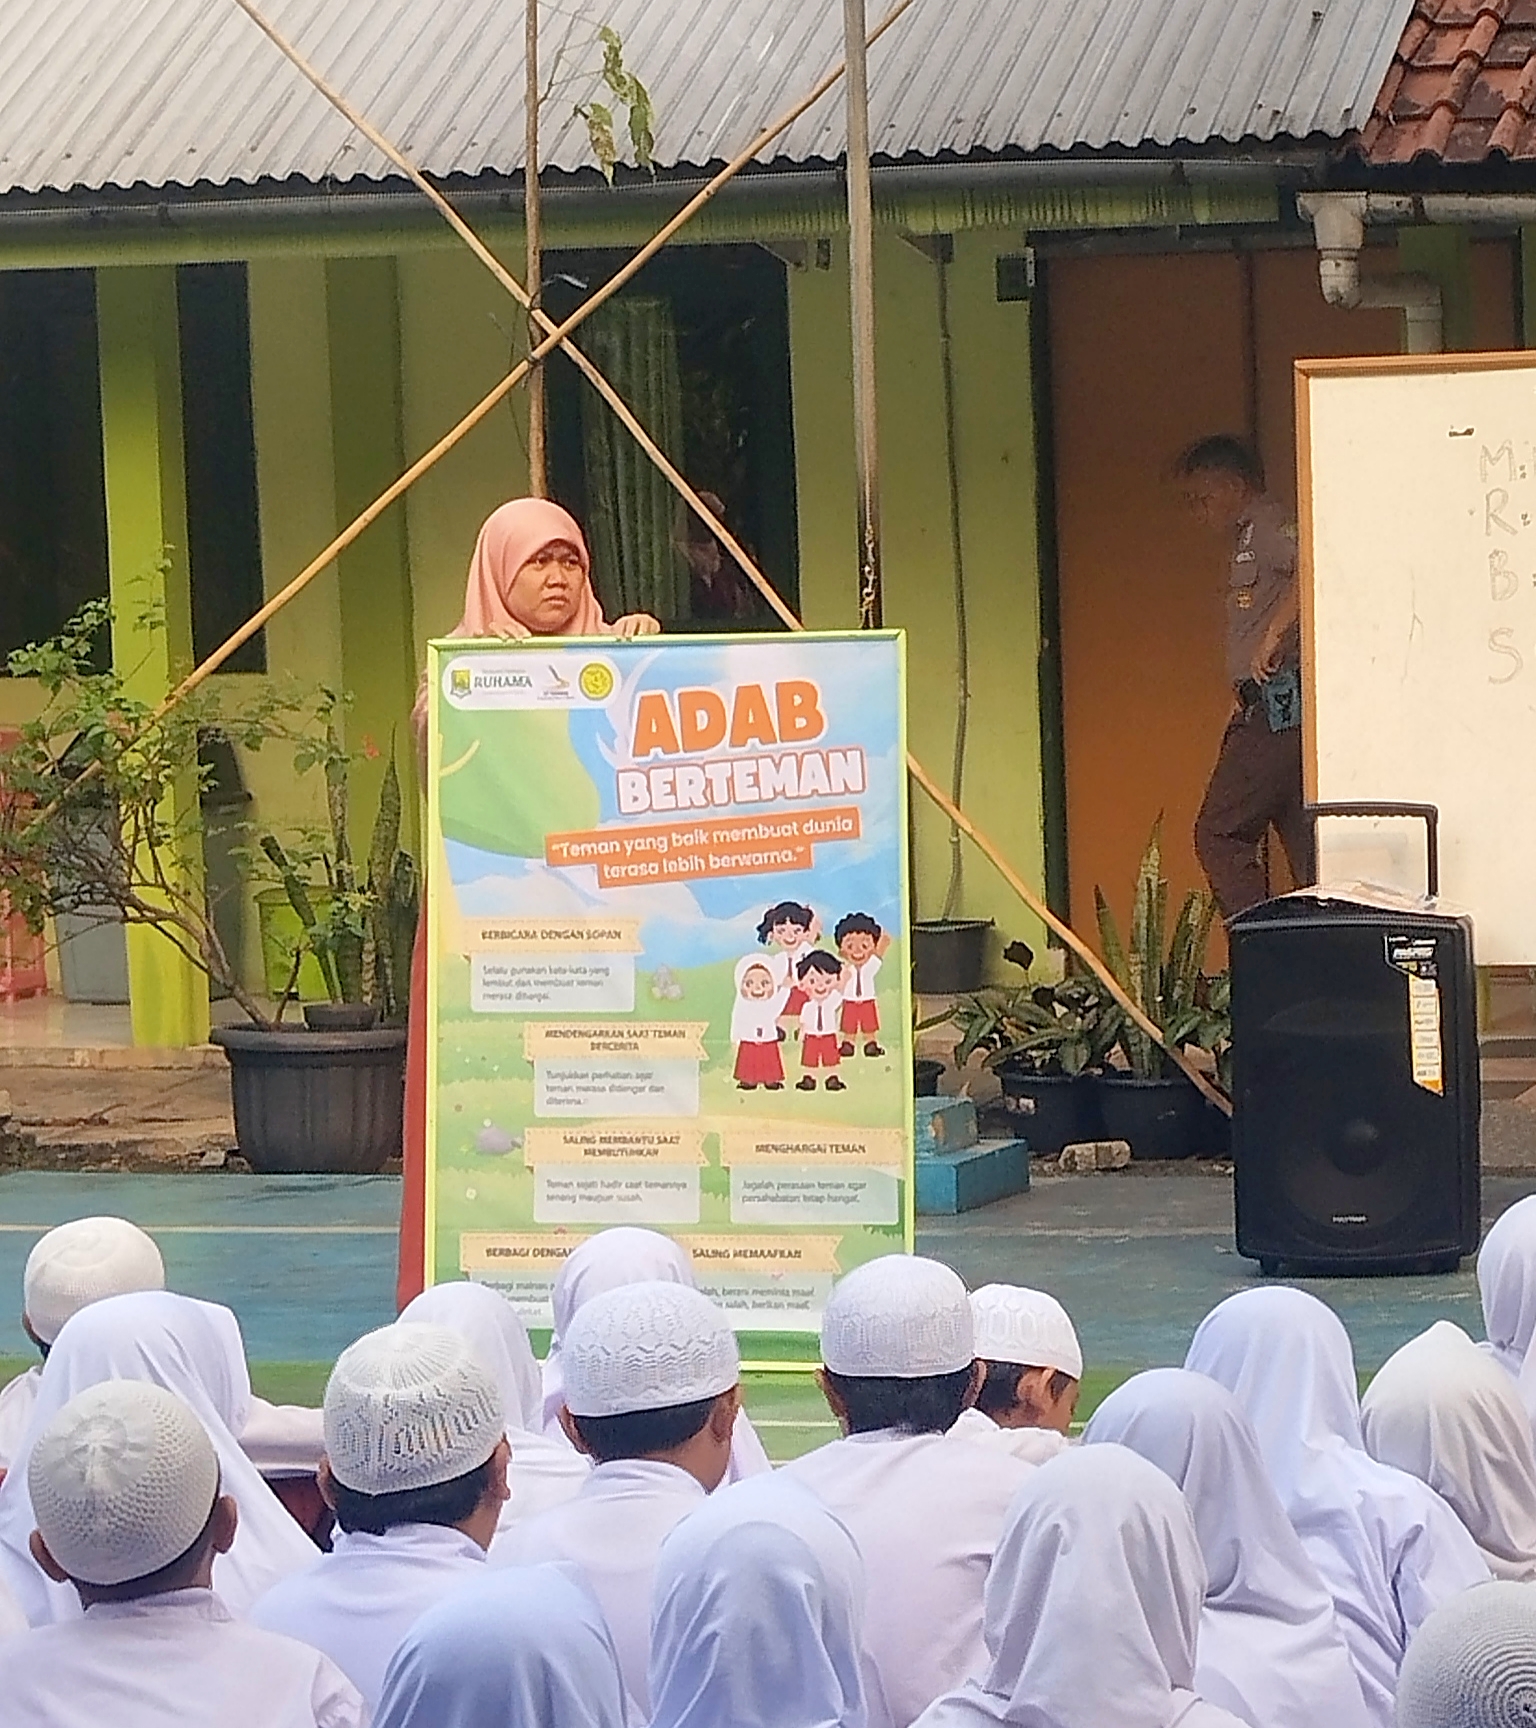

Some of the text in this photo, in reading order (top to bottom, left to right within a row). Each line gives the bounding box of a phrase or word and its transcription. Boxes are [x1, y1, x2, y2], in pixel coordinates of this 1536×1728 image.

[473, 675, 533, 689] RUHAMA
[632, 680, 825, 757] ADAB
[618, 749, 865, 814] BERTEMAN
[552, 814, 853, 860] "Teman yang baik membuat dunia
[602, 846, 805, 880] terasa lebih berwarna."
[481, 929, 622, 940] BERBICARA DENGAN SOPAN
[510, 965, 547, 977] gunakan
[588, 966, 610, 977] yang
[544, 1029, 686, 1039] MENDENGARKAN SAAT TEMAN
[590, 1041, 640, 1051] BERCERITA
[562, 1135, 680, 1145] SALING MEMBANTU SAAT
[583, 1148, 659, 1157] MEMBUTUHKAN
[755, 1143, 866, 1154] MENGHARGAI TEMAN
[600, 1179, 622, 1189] hadir
[485, 1247, 530, 1258] BERBAGI
[692, 1248, 802, 1259] SALING MEMAAFKAN
